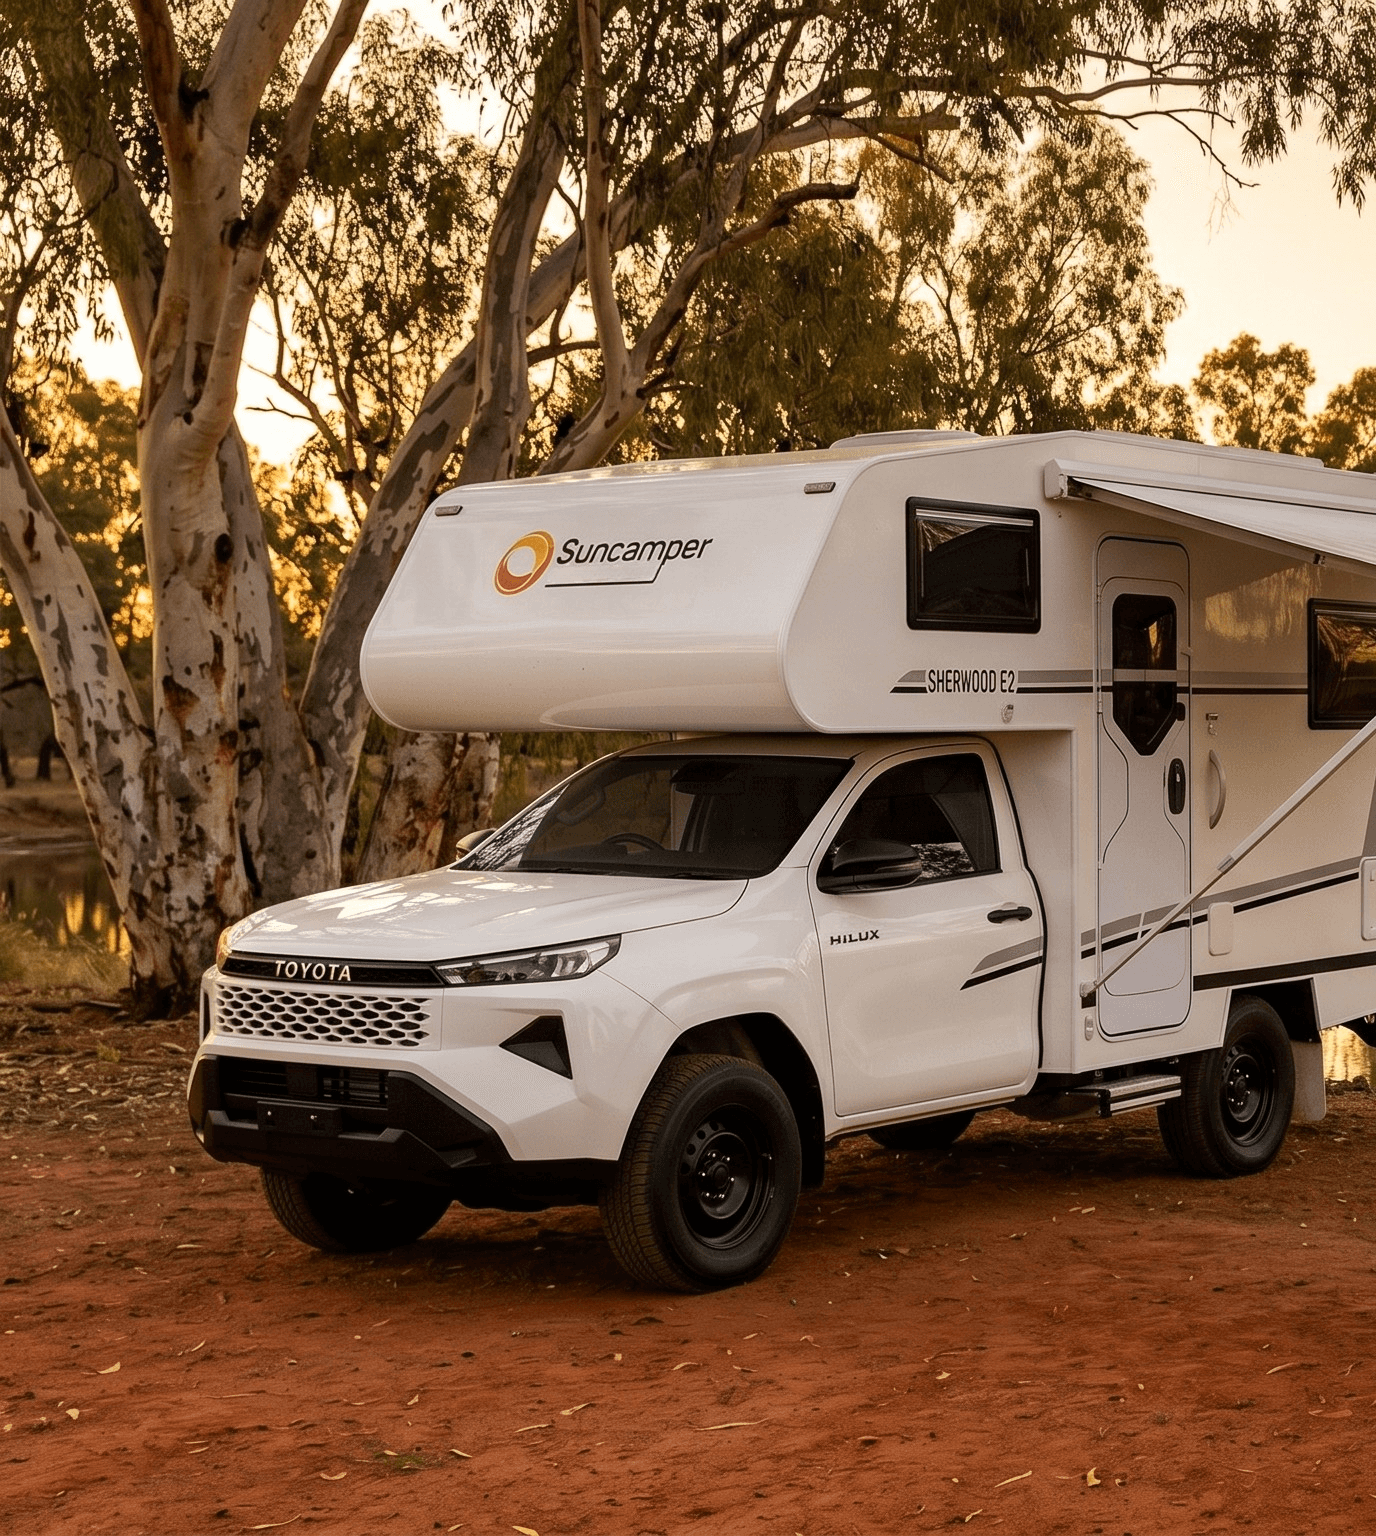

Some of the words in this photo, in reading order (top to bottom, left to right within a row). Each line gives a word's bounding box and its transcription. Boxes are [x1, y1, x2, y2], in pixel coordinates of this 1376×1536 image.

[556, 537, 714, 566] Suncamper
[927, 669, 997, 693] SHERWOOD
[1000, 669, 1015, 693] E2
[829, 929, 880, 946] HILUX
[275, 960, 352, 982] TOYOTA
